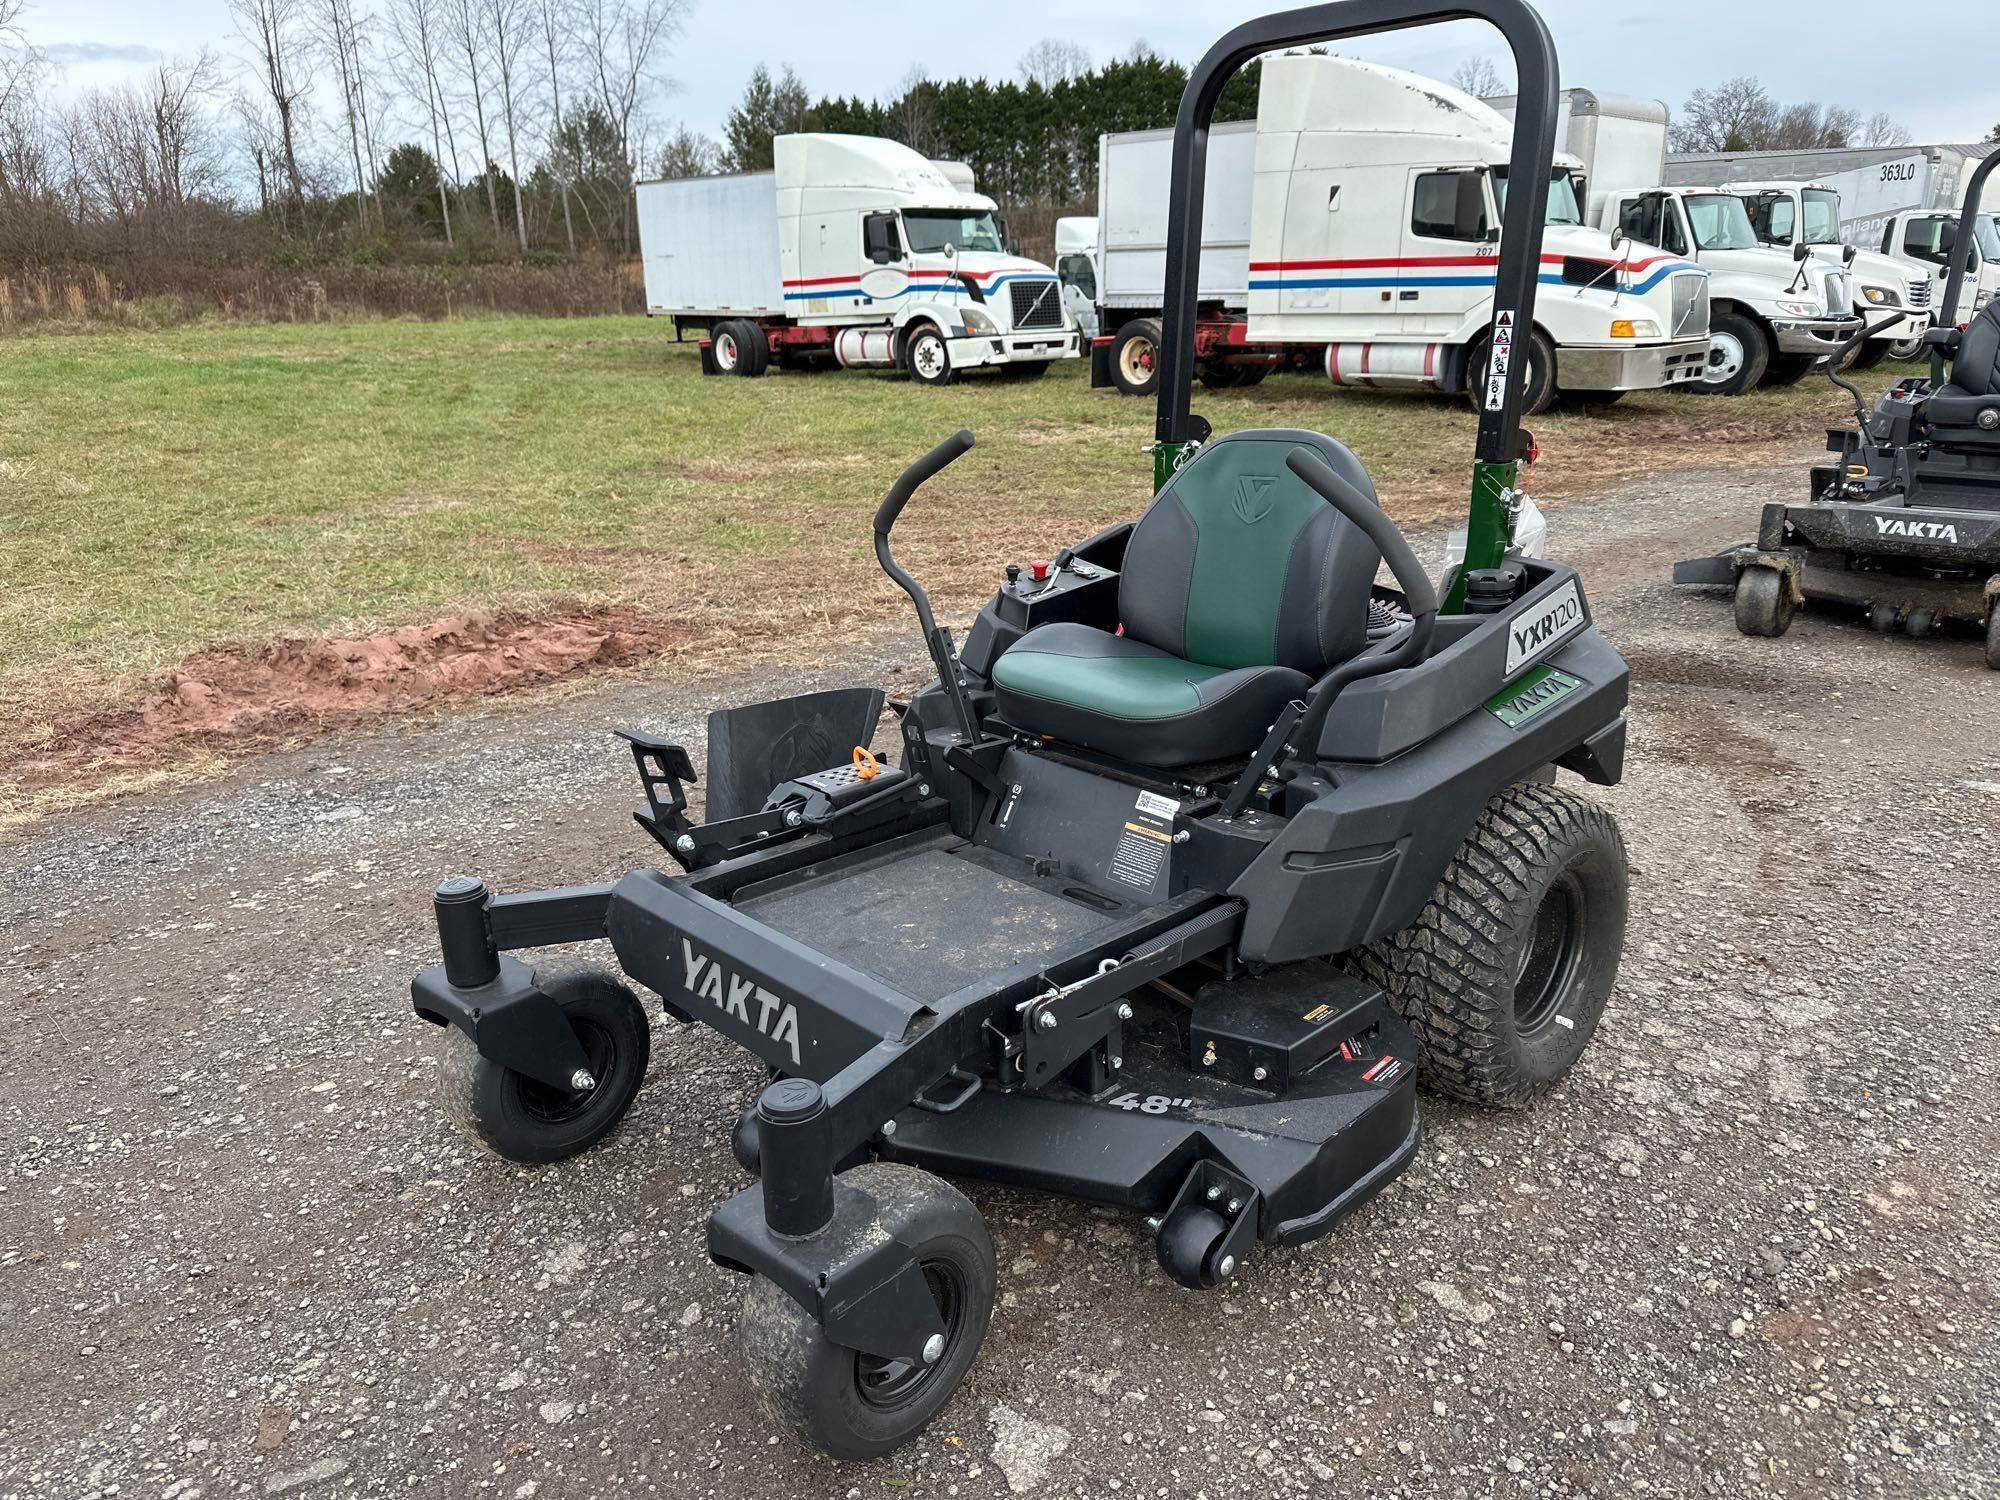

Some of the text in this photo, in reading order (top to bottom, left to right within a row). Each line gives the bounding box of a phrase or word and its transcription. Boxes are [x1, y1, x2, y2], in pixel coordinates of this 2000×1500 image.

[1475, 247, 1493, 256] 207
[1874, 515, 1958, 544] YAKTA
[1513, 597, 1577, 657] YXR120
[1499, 677, 1572, 715] YAKTA
[682, 937, 801, 1066] YAKTA
[1108, 1092, 1193, 1114] 48"
